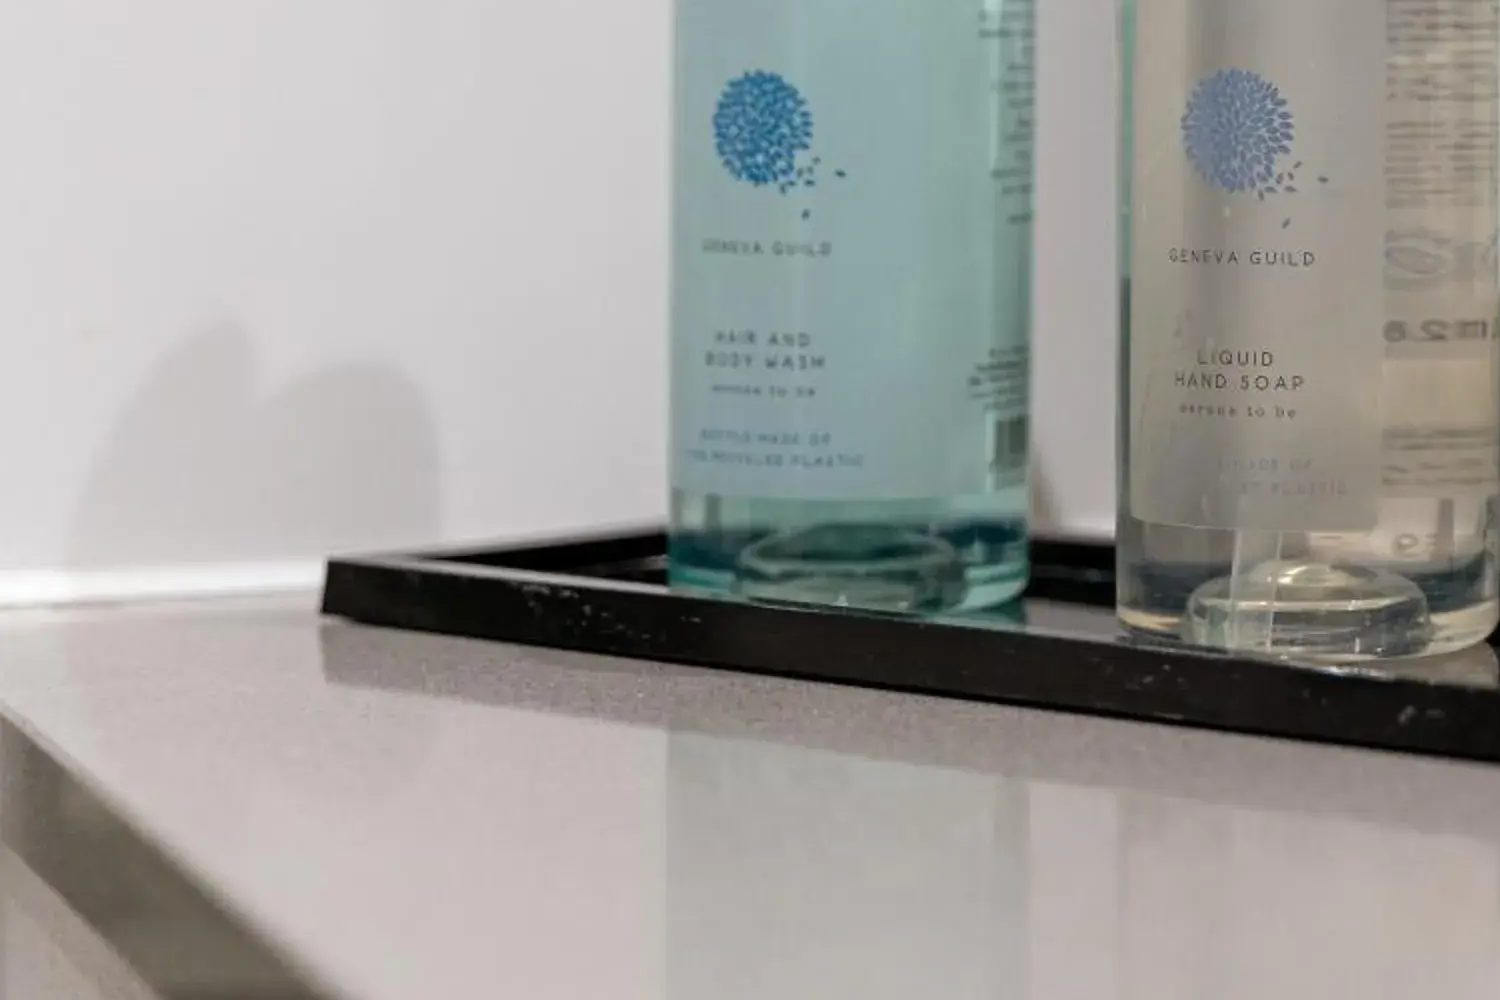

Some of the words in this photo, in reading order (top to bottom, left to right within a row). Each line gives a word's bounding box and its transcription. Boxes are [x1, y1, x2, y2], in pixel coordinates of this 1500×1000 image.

[1168, 247, 1239, 266] GENEVA
[1249, 250, 1316, 268] GUILD
[1196, 348, 1275, 368] LIQUID
[1174, 369, 1228, 389] HAND
[1240, 374, 1305, 392] SOAP
